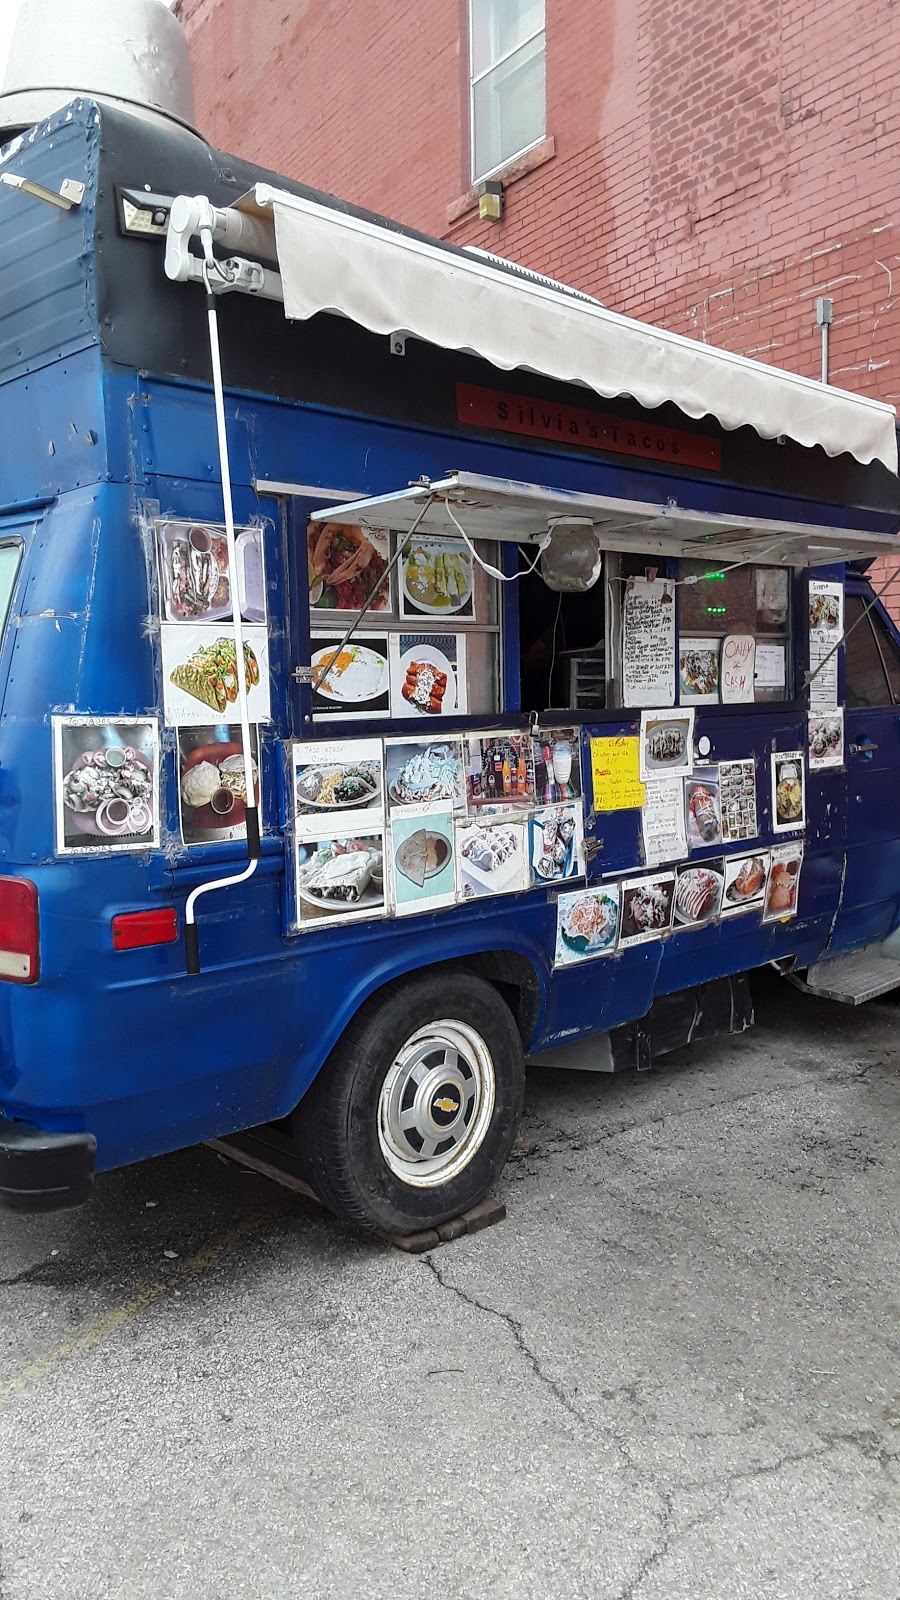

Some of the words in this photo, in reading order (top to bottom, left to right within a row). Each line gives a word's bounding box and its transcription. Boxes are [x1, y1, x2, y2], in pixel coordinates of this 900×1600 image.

[497, 400, 598, 439] Silvia's
[611, 425, 680, 455] Tacos
[725, 671, 746, 690] CASH
